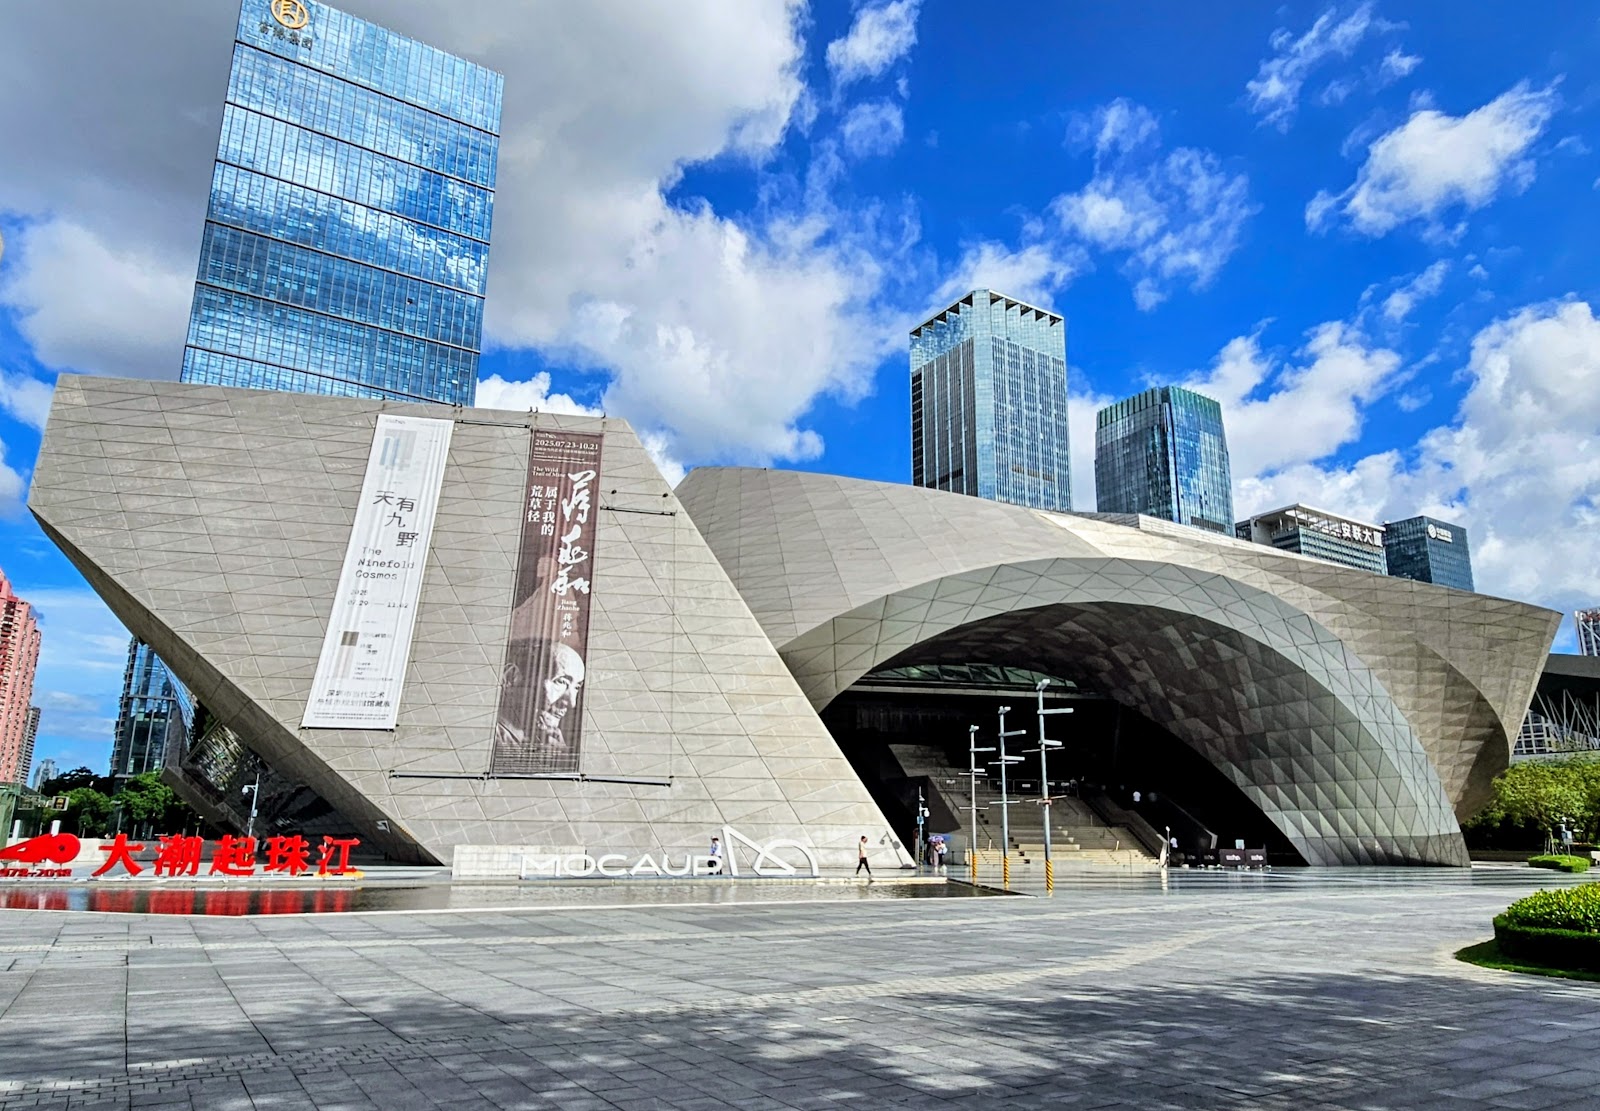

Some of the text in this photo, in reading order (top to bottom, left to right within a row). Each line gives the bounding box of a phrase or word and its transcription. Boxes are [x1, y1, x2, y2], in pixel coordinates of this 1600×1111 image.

[534, 439, 599, 450] 2025.07.23-10.21
[527, 485, 544, 523] 荒草径
[541, 486, 558, 537] 属于我的
[1341, 522, 1383, 548] 安联大厦
[362, 546, 382, 556] The
[355, 569, 398, 580] Cosmos
[357, 558, 415, 569] Ninefold
[92, 834, 362, 877] 大潮起珠江
[519, 853, 724, 877] MOCAUP
